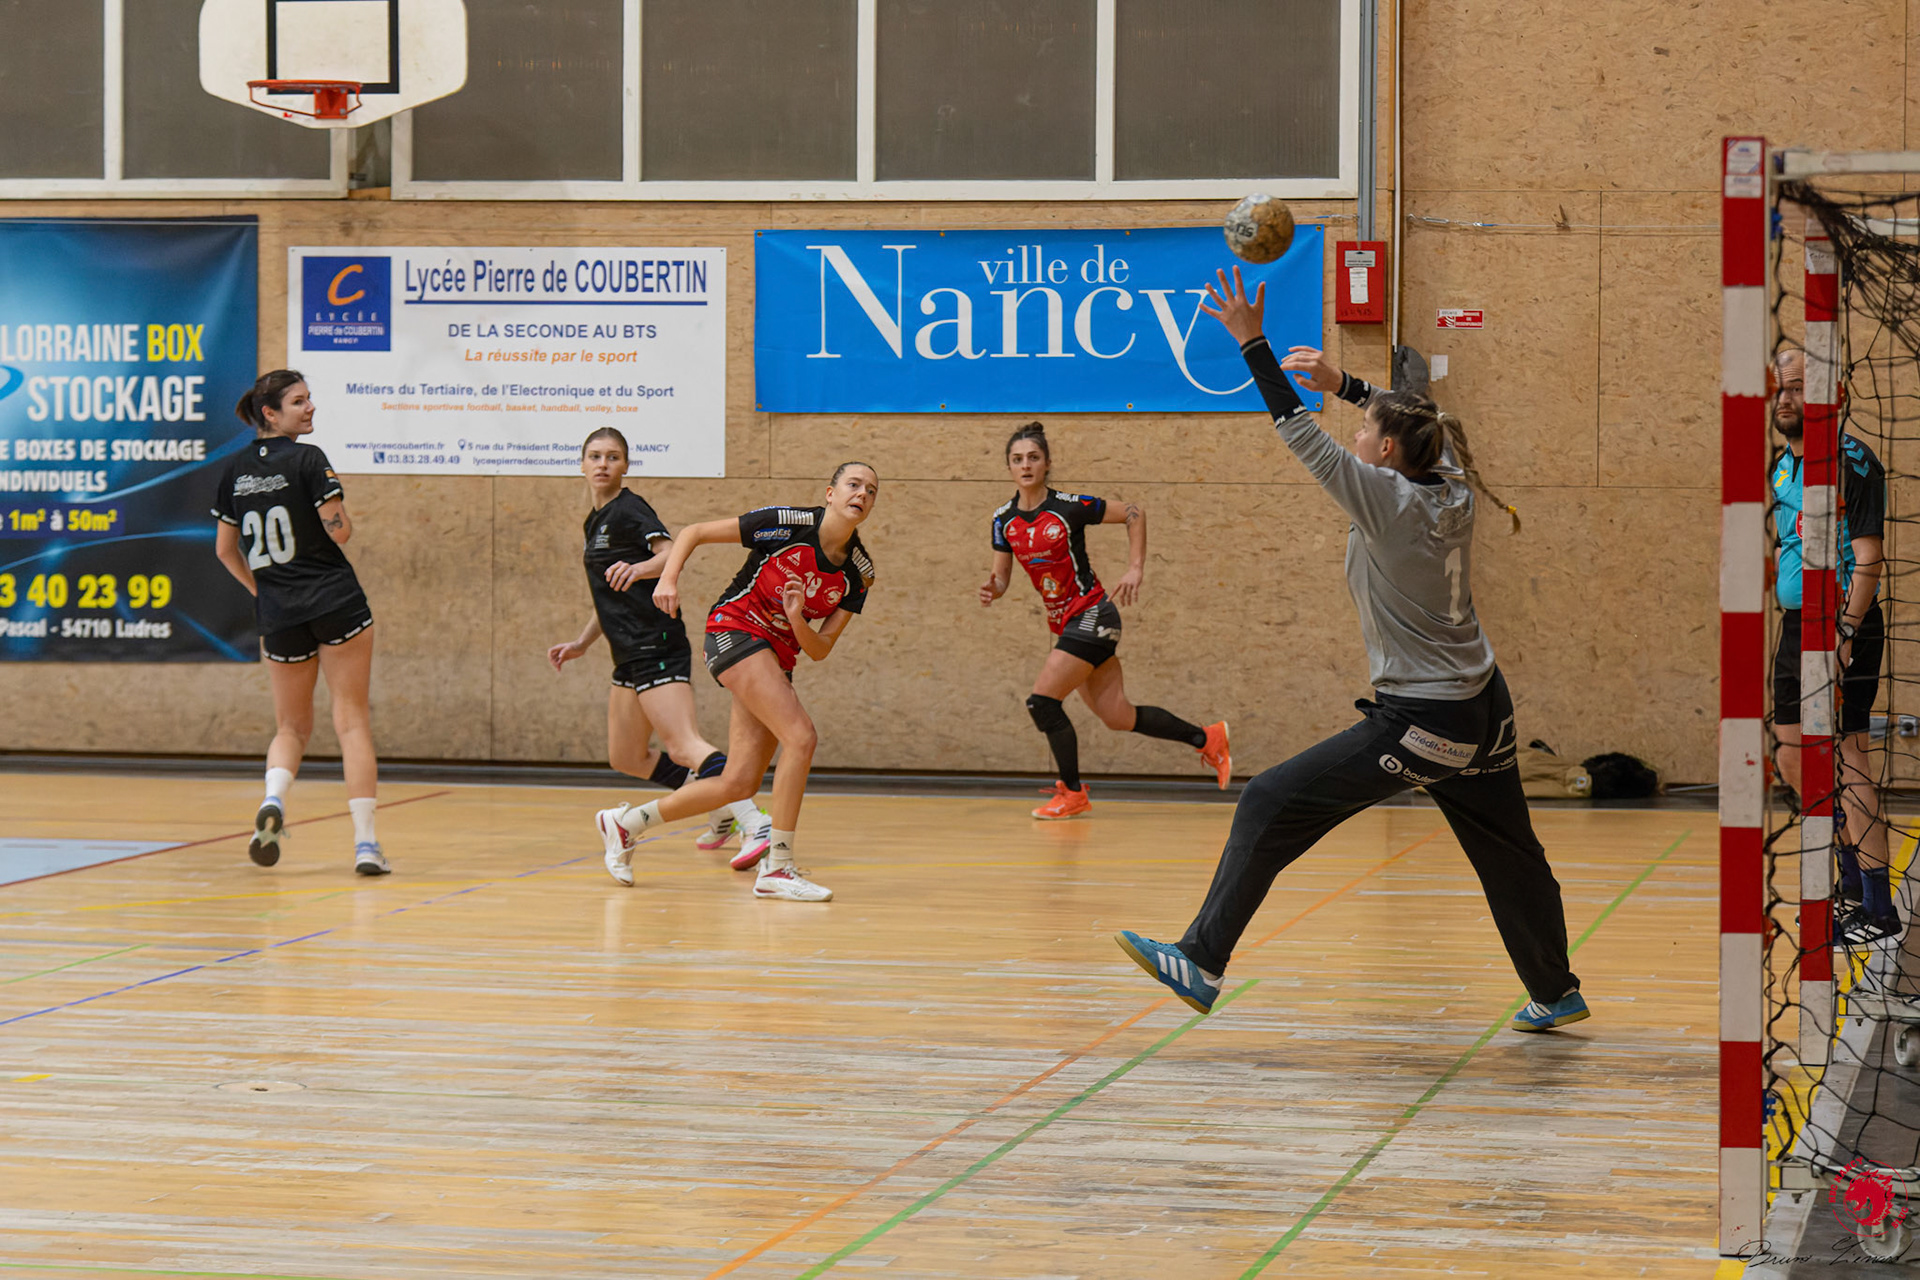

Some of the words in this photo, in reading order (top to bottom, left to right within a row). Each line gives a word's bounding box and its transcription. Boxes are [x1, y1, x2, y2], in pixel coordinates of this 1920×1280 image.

[978, 245, 1068, 284] ville
[1080, 244, 1130, 284] de
[405, 258, 466, 301] Lycée
[473, 260, 535, 294] Pierre
[542, 260, 568, 293] de
[575, 259, 707, 293] COUBERTIN
[806, 245, 1271, 394] Nancy
[308, 326, 333, 336] PIERRE
[343, 326, 385, 336] COUBERTIN
[448, 324, 471, 337] DE
[477, 324, 499, 338] LA
[504, 324, 588, 338] SECONDE
[593, 325, 618, 338] AU
[623, 325, 657, 339] BTS
[1, 323, 140, 362] LORRAINE
[146, 323, 205, 362] BOX
[464, 349, 483, 362] La
[486, 348, 547, 362] réussite
[551, 351, 577, 365] par
[580, 350, 594, 362] le
[598, 350, 638, 365] sport
[27, 375, 206, 421] STOCKAGE
[345, 383, 394, 396] Métiers
[398, 383, 416, 396] du
[419, 383, 478, 397] Tertiaire,
[481, 384, 498, 396] de
[502, 384, 595, 400] l'Electronique
[599, 386, 612, 397] et
[615, 385, 633, 397] du
[636, 385, 675, 399] Sport
[381, 402, 420, 411] Sections
[423, 402, 464, 412] sportives
[466, 403, 504, 413] football,
[506, 403, 538, 413] basket,
[541, 404, 582, 413] handball,
[616, 405, 639, 413] boxe
[0, 439, 10, 460] E
[14, 438, 76, 461] BOXES
[80, 439, 107, 461] DE
[110, 439, 207, 461] STOCKAGE
[345, 441, 445, 451] www.lyceecoubertin.fr
[492, 443, 504, 451] du
[507, 443, 550, 452] Président
[552, 443, 582, 452] Robert
[635, 444, 670, 453] NANCY
[387, 453, 461, 465] 03.83.28.49.49
[0, 470, 108, 492] NDIVIDUELS
[9, 508, 46, 531] 1m²
[50, 508, 64, 531] à
[67, 508, 118, 531] 50m²
[242, 505, 297, 571] 20
[0, 573, 17, 608] 3
[27, 573, 68, 609] 40
[77, 573, 118, 609] 23
[127, 574, 172, 609] 99
[1444, 546, 1462, 626] 1
[61, 619, 112, 639] 54710
[115, 619, 172, 640] Ludres
[1409, 730, 1439, 750] Crédit
